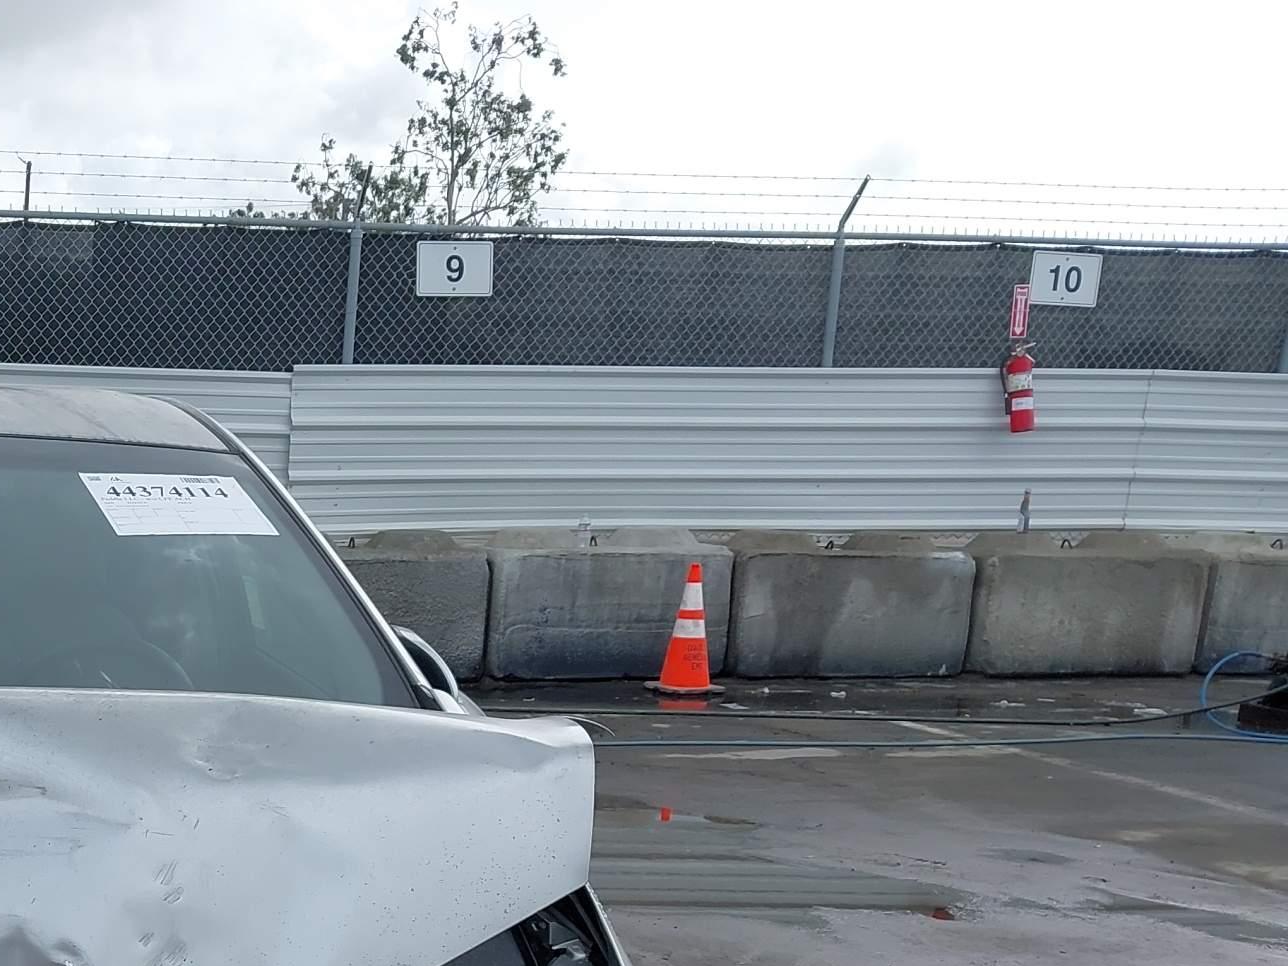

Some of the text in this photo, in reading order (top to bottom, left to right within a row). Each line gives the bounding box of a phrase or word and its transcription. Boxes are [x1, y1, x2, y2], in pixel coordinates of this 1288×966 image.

[446, 255, 465, 283] 9
[1049, 264, 1082, 294] 10
[106, 485, 229, 498] 44374114
